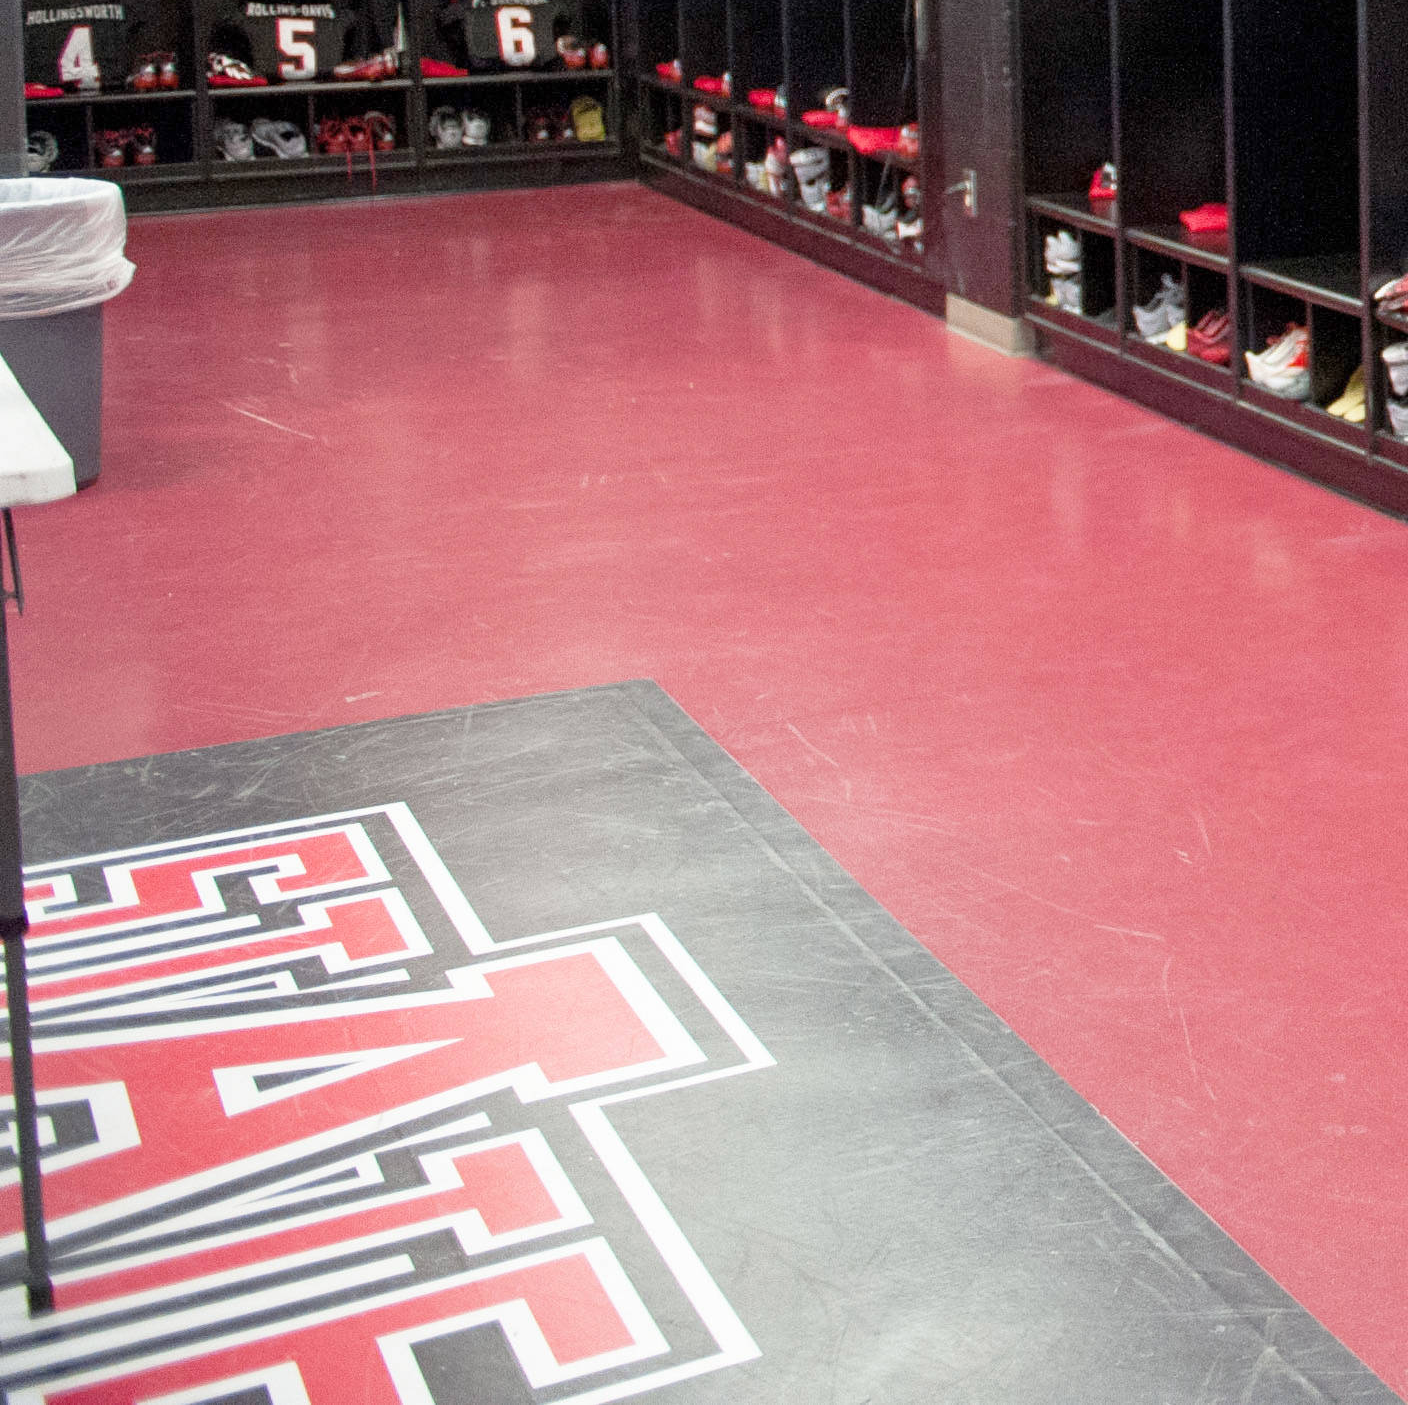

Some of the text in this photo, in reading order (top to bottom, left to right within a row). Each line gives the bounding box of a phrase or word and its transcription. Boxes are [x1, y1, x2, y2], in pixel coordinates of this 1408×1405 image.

[26, 3, 125, 26] HOLLINGSWORTH
[494, 5, 536, 67] 6
[58, 24, 101, 90] 4
[275, 17, 317, 81] 5
